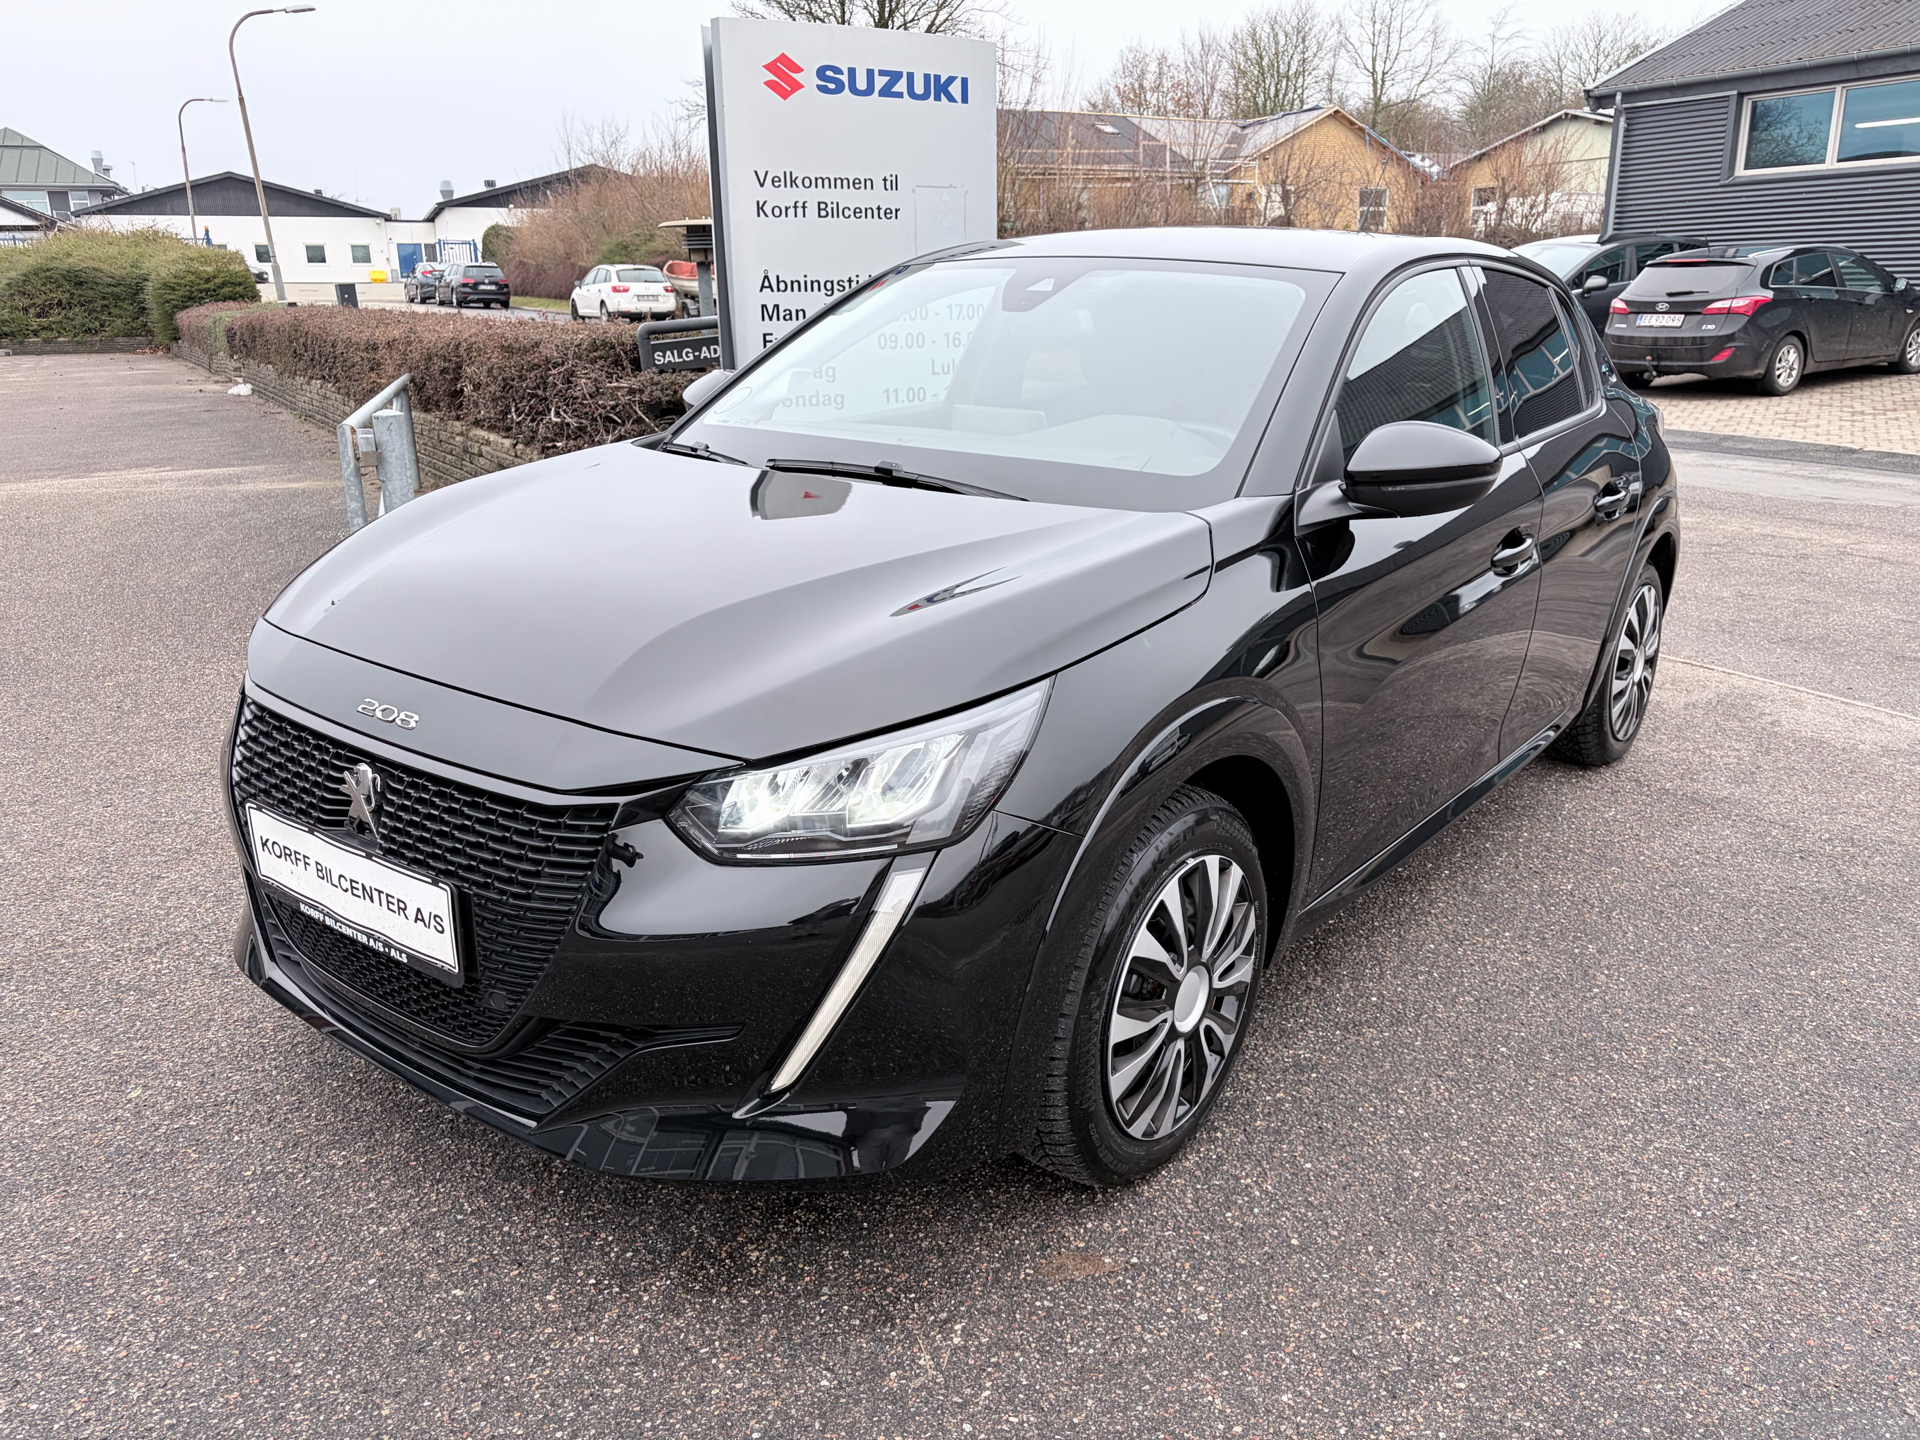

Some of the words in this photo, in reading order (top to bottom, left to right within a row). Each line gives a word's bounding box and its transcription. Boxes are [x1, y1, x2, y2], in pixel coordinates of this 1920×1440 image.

[815, 64, 969, 104] SUZUKI
[753, 170, 874, 191] Velkommen
[881, 173, 899, 192] til
[755, 200, 808, 218] Korff
[817, 201, 900, 220] Bilcenter
[759, 269, 873, 297] Åbningsti
[760, 303, 807, 322] Man
[877, 332, 926, 350] 09.00
[653, 345, 720, 365] SALG-AD
[882, 386, 927, 404] 11.00
[356, 698, 420, 731] 208
[259, 835, 311, 872] KORFF
[314, 860, 409, 923] BILCENTER
[414, 907, 446, 935] A/S
[300, 903, 324, 922] KORFF
[324, 916, 369, 945] BILCENTER
[369, 938, 384, 953] A/S
[390, 947, 408, 963] ALS
